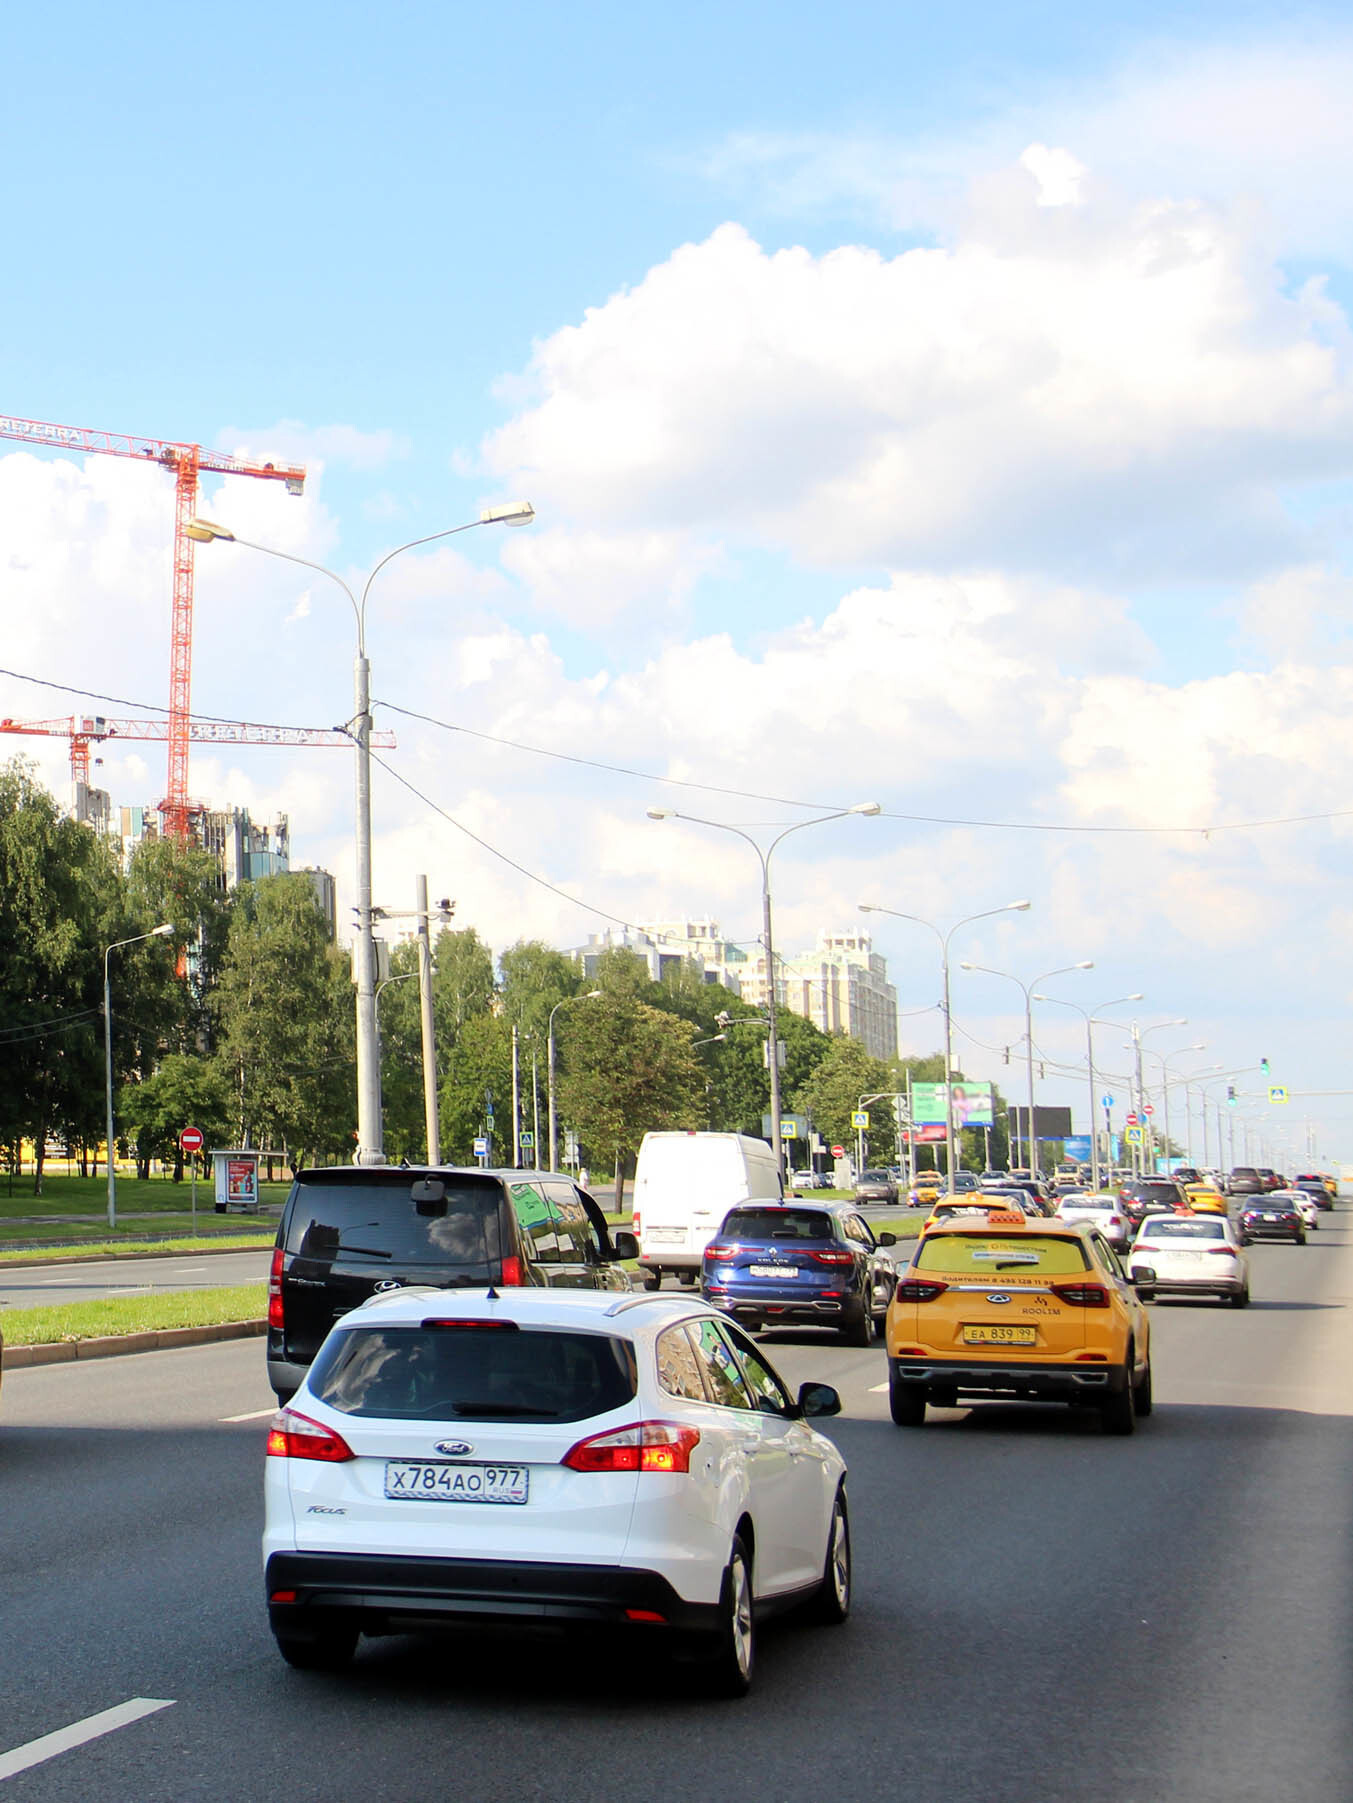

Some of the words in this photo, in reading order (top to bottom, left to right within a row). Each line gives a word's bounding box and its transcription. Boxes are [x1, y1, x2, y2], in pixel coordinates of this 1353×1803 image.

[991, 1328, 1013, 1339] 839
[1018, 1328, 1031, 1336] 99
[486, 1469, 521, 1486] 977
